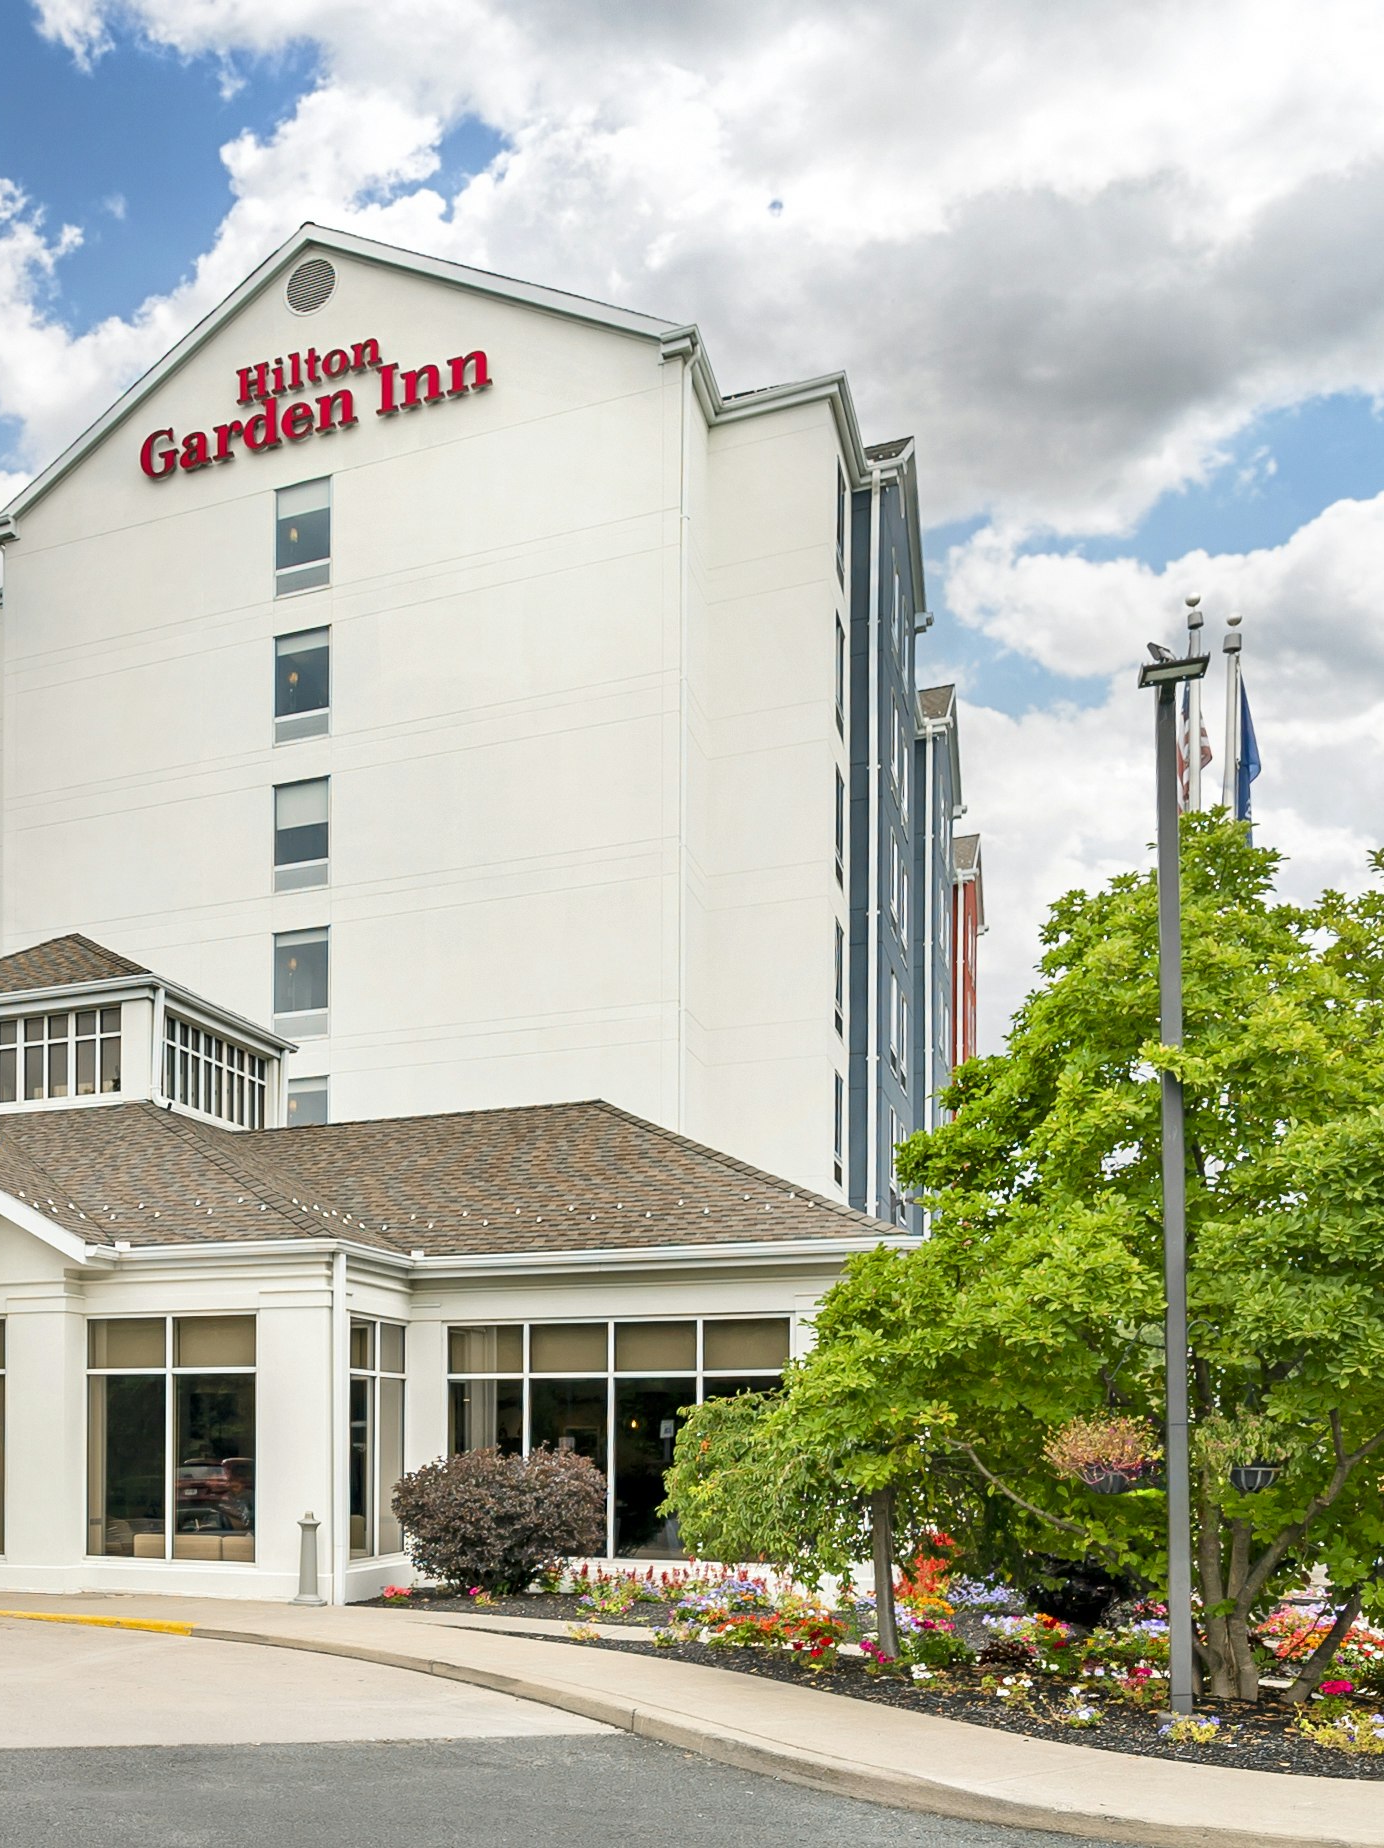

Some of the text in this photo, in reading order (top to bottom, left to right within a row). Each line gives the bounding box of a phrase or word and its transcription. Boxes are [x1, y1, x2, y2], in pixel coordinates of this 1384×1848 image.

[140, 349, 493, 479] Garden Inn
[236, 337, 383, 405] Hilton
